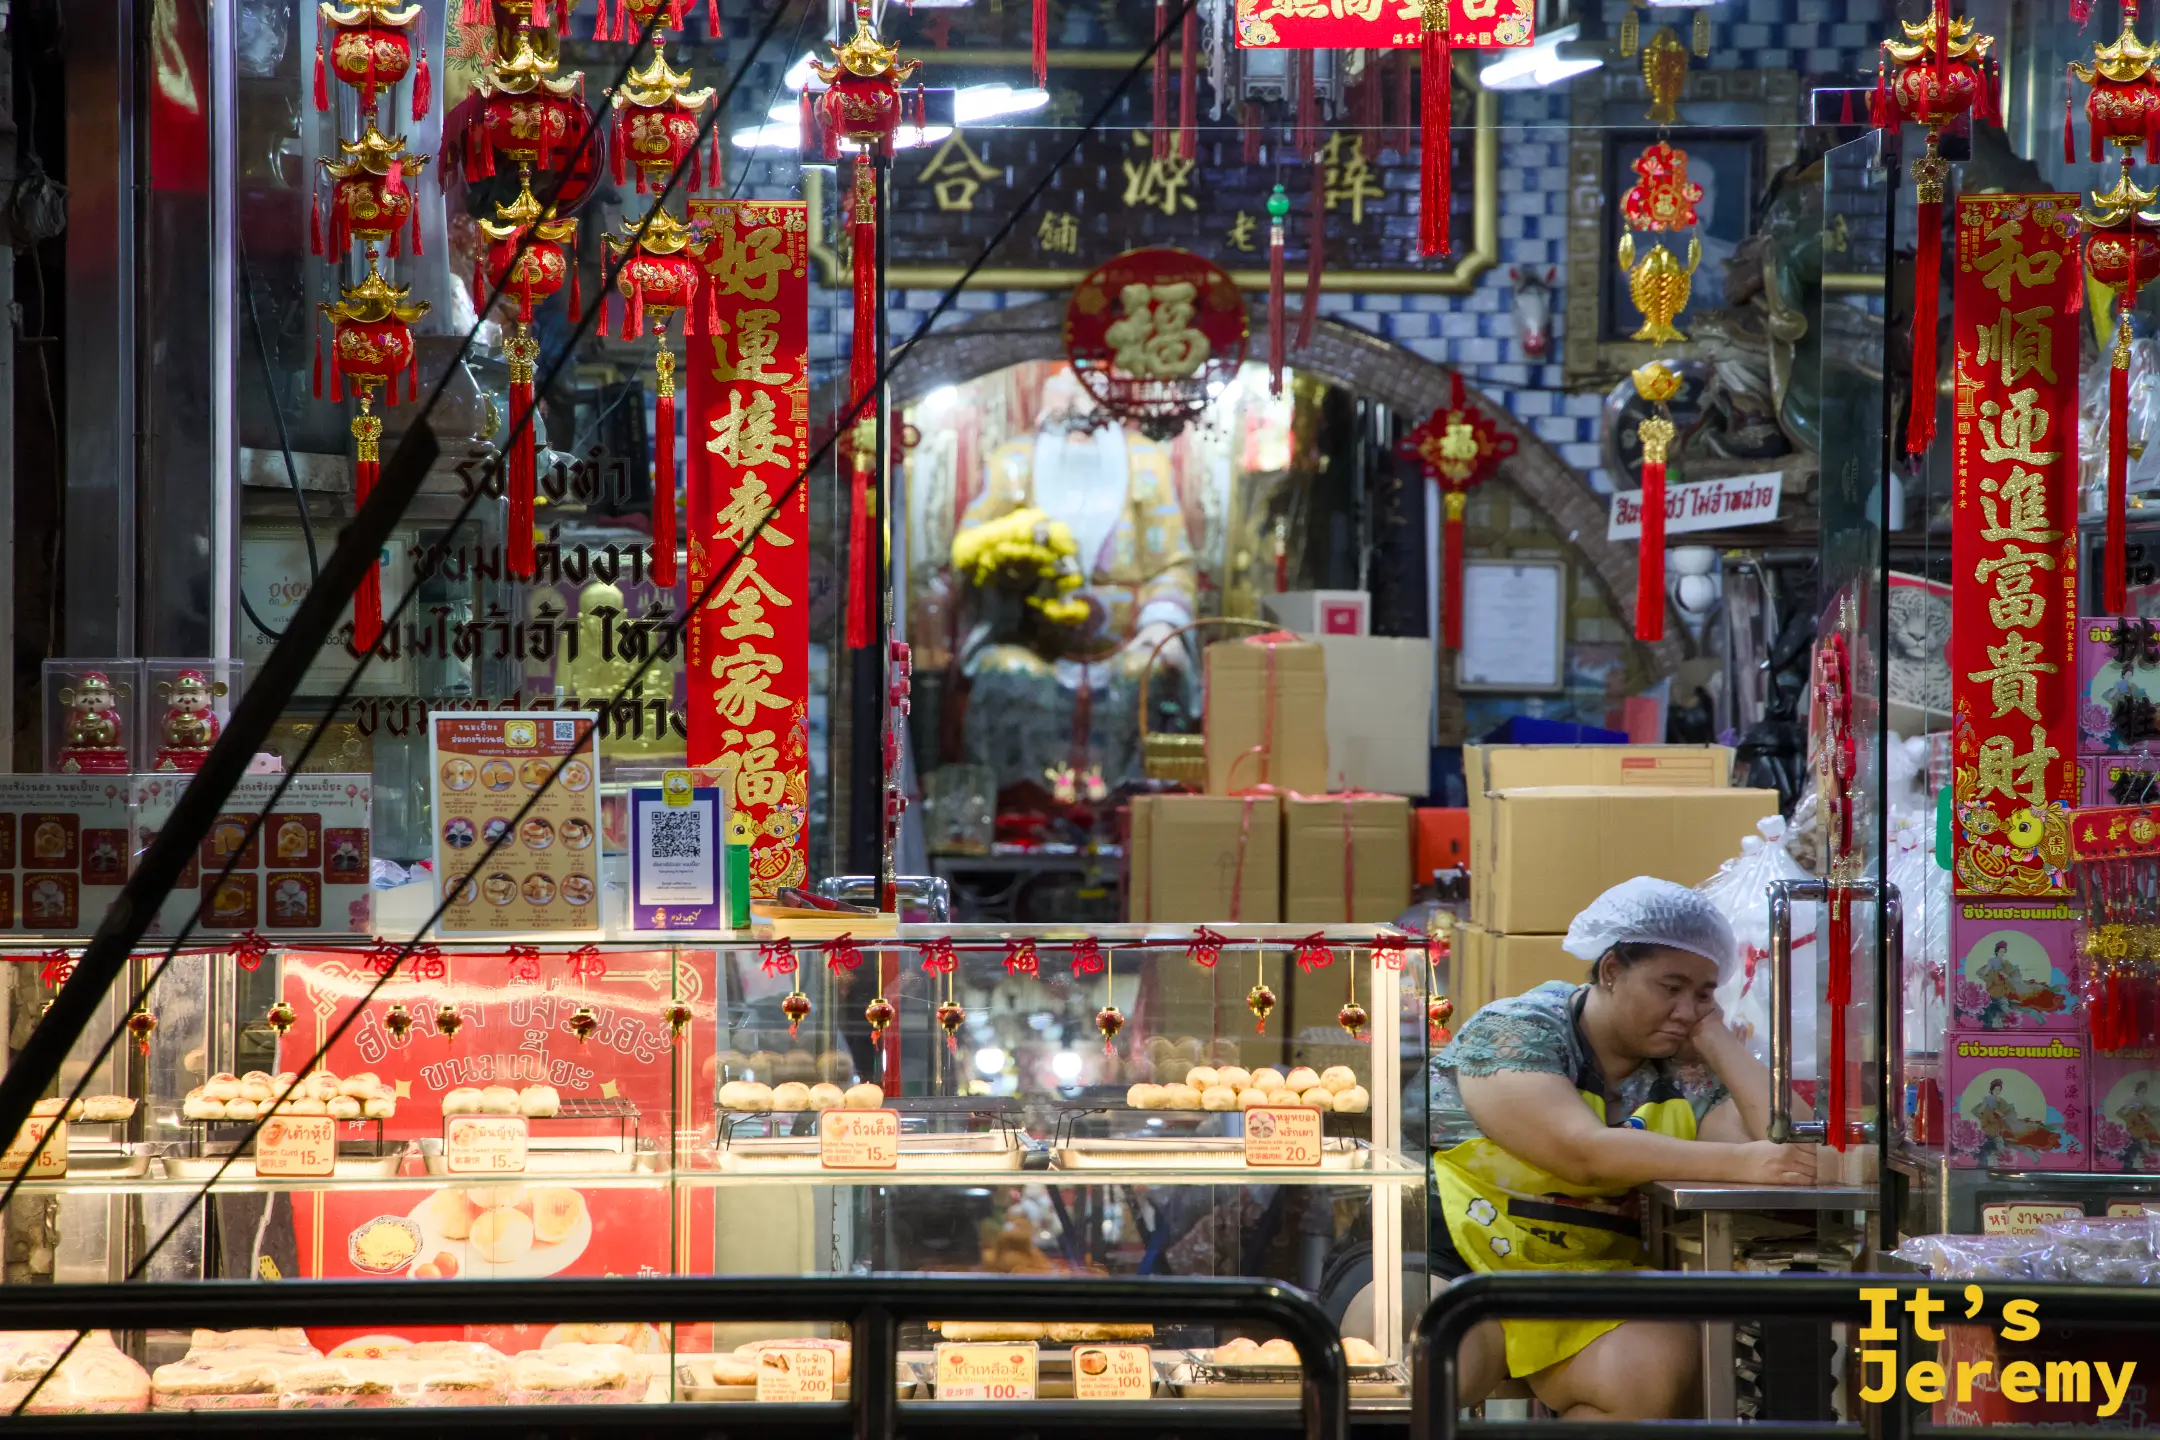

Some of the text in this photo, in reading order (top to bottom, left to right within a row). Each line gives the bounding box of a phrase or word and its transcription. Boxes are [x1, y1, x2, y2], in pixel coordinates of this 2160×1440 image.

[1105, 282, 1210, 379] 福
[797, 441, 808, 513] 五福臨家富貴
[420, 1029, 594, 1091] ขนมเปี๊ยะ
[984, 1384, 1029, 1399] 100.-
